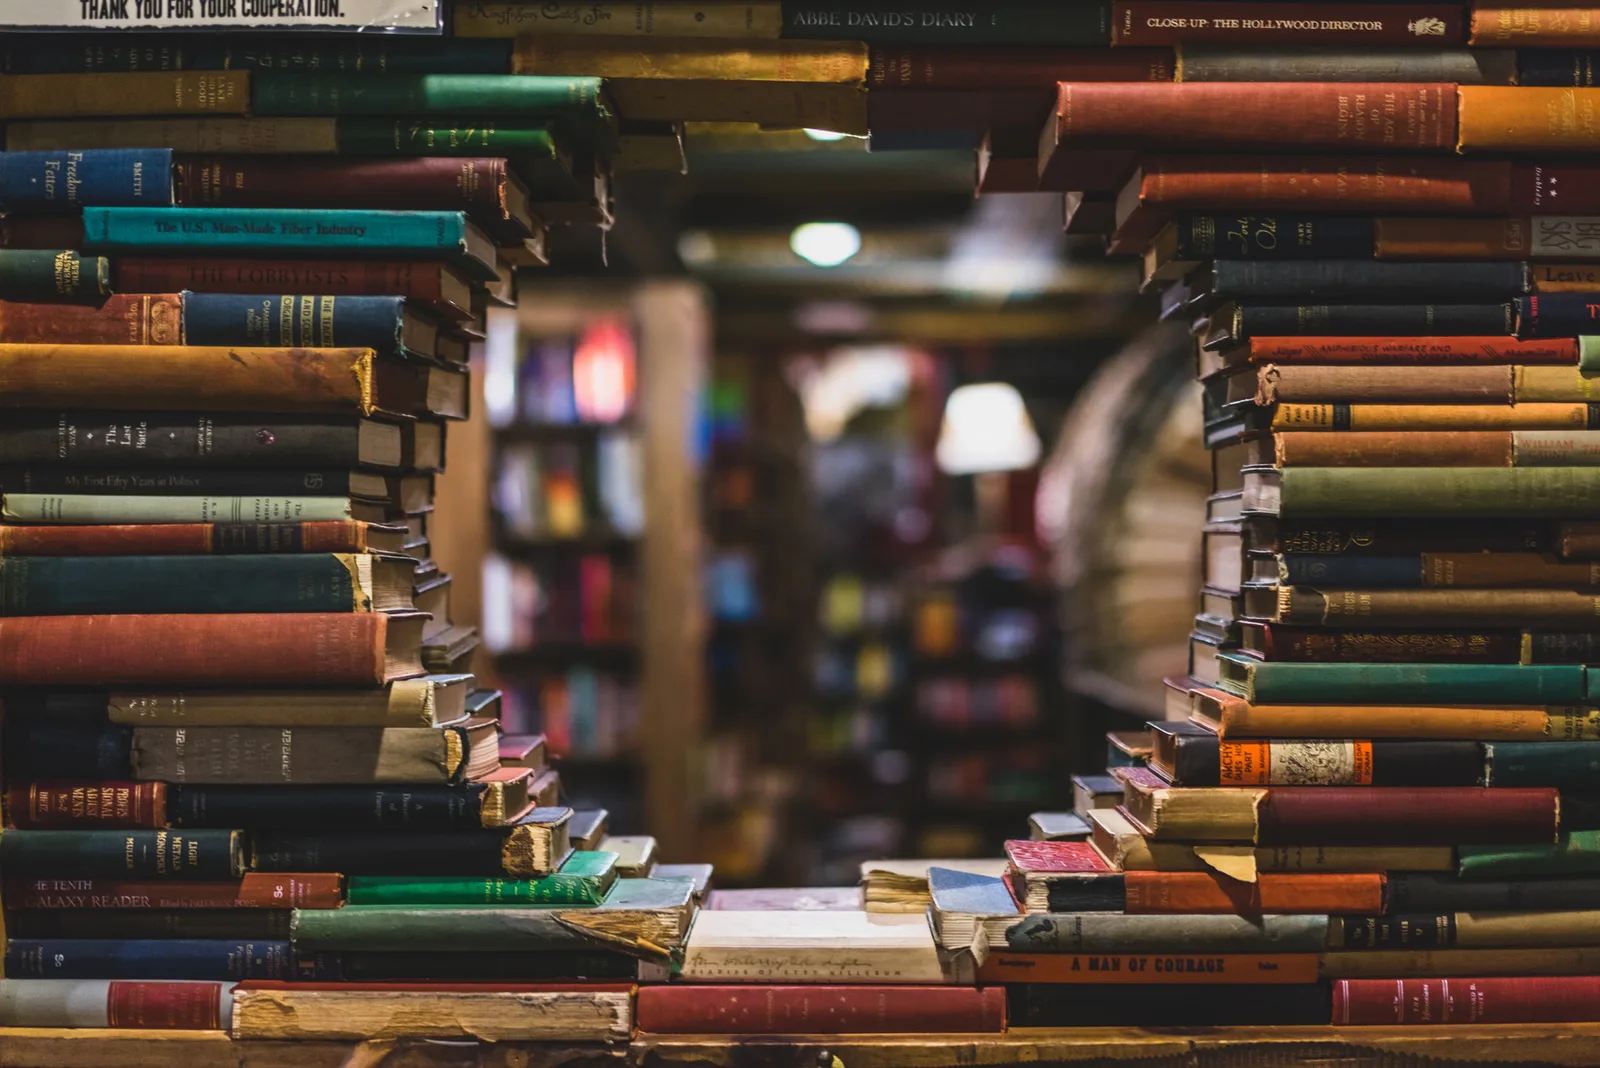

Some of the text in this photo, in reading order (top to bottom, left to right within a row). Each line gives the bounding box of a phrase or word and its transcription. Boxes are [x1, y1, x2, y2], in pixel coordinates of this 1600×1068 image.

[82, 0, 345, 19] THANK YOU FOR YOUR COOPERATION.
[793, 11, 978, 27] ABBE DAVID'S DIARY
[1146, 18, 1383, 32] CLOSE-UP: THE HOLLYWOOD DIRECTOR
[1384, 93, 1395, 114] THE
[133, 162, 143, 196] SMITH
[155, 221, 177, 233] The
[211, 222, 276, 235] Man-Made
[281, 223, 313, 235] Fiber
[316, 222, 367, 238] Industry
[1540, 221, 1572, 251] SKY
[237, 267, 349, 285] LOBBYISTS
[1545, 267, 1596, 282] Leave
[1430, 345, 1452, 353] AND
[105, 424, 117, 446] The
[120, 425, 132, 446] Last
[136, 421, 148, 449] Battle
[1520, 439, 1574, 449] WILLIAM
[130, 475, 155, 486] Years
[157, 475, 167, 486] in
[294, 504, 302, 516] The
[1222, 744, 1233, 779] ARCHY
[1244, 751, 1252, 773] PART
[156, 831, 167, 875] MONOPOLY
[172, 836, 182, 872] METALS
[188, 840, 198, 866] LIGHT
[51, 879, 93, 891] TENTH
[273, 885, 284, 899] Sc
[26, 895, 86, 908] GALAXY
[91, 895, 151, 908] READER
[54, 954, 64, 968] Sc
[1071, 957, 1225, 973] A MAN OF COURAGE
